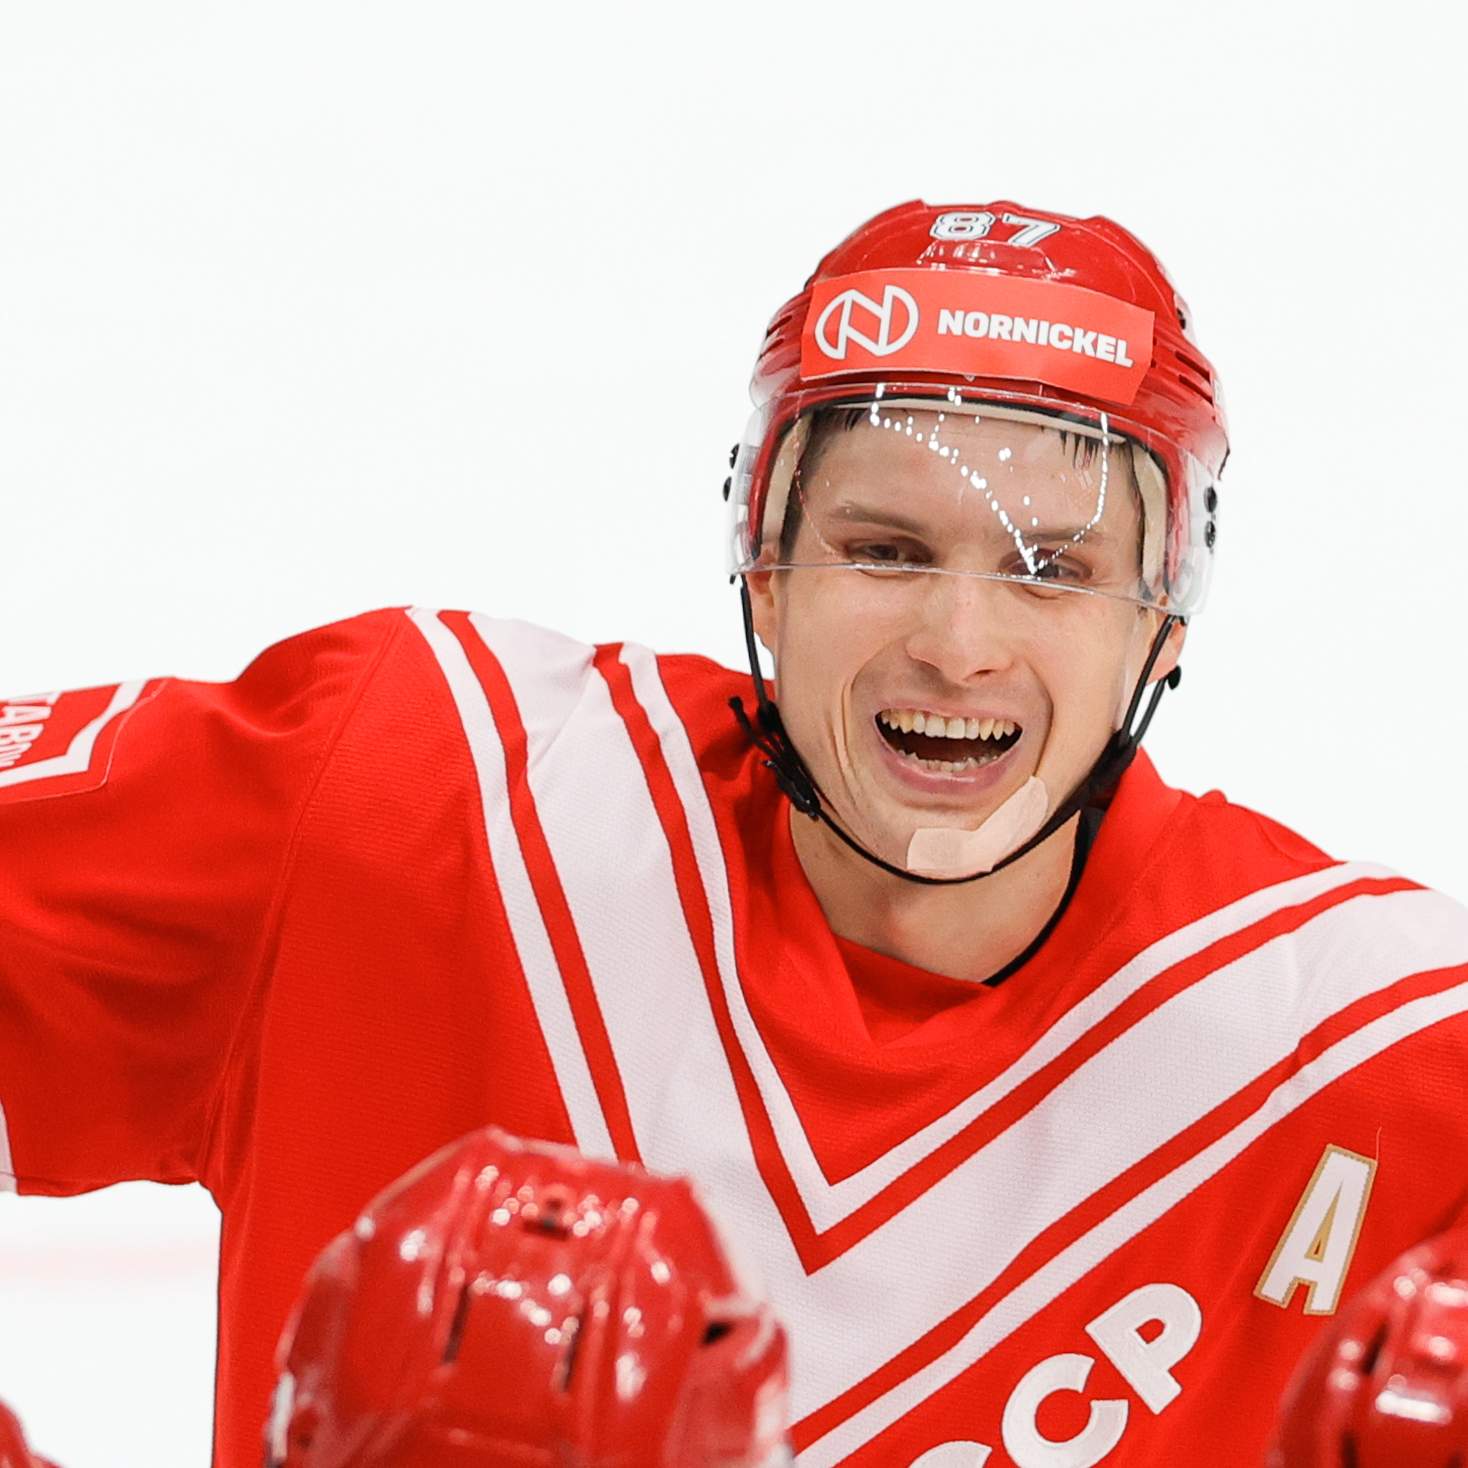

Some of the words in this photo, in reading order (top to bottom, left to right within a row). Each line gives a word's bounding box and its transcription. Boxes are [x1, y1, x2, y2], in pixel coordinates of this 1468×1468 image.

[929, 211, 1060, 247] 87
[938, 308, 1134, 368] NORNICKEL
[1253, 1143, 1378, 1316] A
